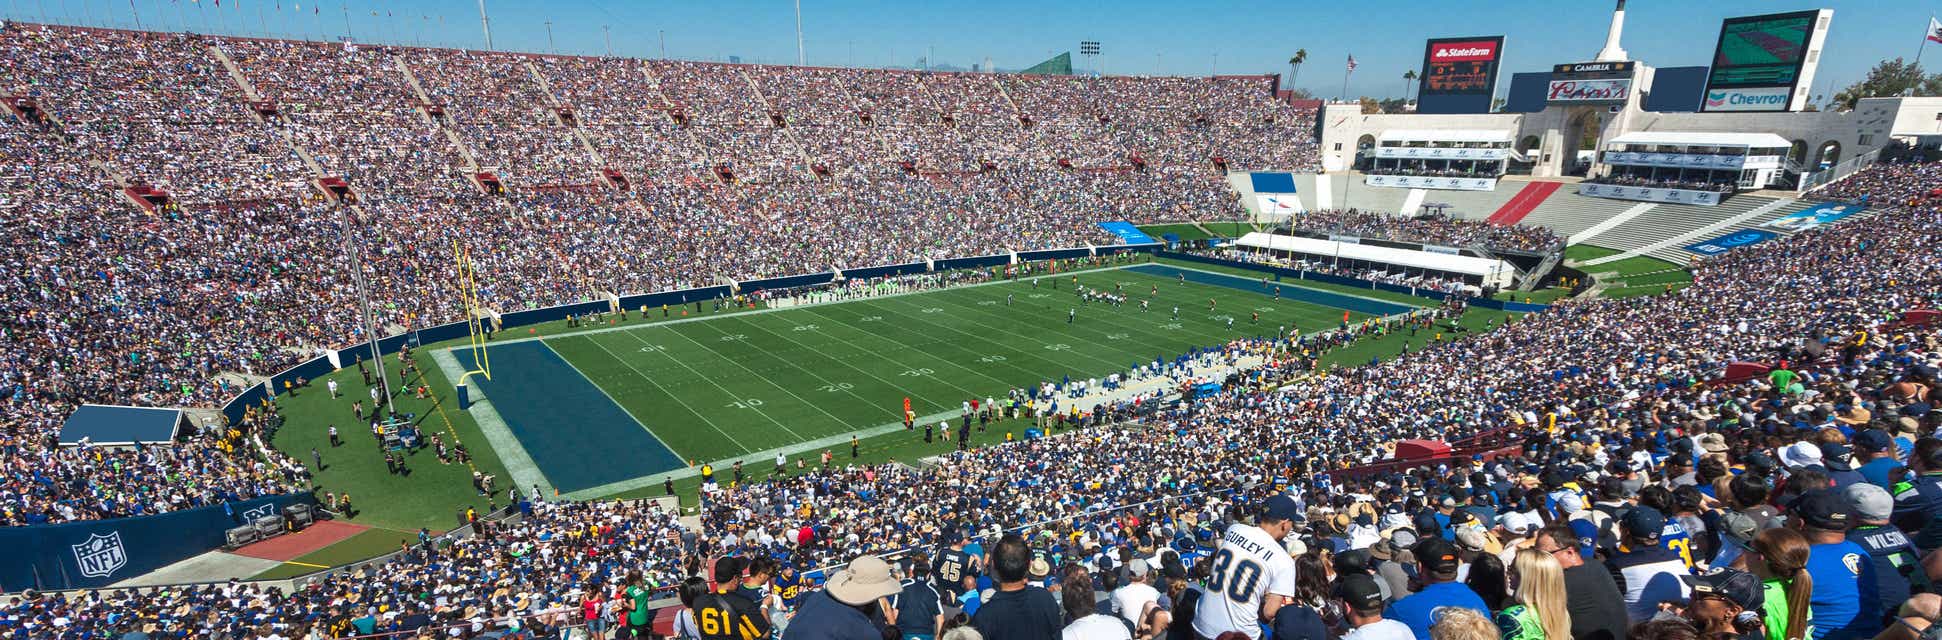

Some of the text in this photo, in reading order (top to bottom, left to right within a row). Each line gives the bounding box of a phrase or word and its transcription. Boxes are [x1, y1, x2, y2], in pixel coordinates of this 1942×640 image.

[1574, 64, 1610, 72] CAMBRIA
[1729, 93, 1787, 105] Chevron
[821, 382, 855, 392] 20
[732, 398, 764, 409] 10
[1225, 530, 1264, 555] GURLEY
[1864, 530, 1910, 550] WILSON
[82, 547, 123, 573] NFL
[940, 560, 962, 583] 45
[1207, 547, 1263, 604] 30
[782, 585, 799, 599] 28
[701, 607, 731, 635] 61
